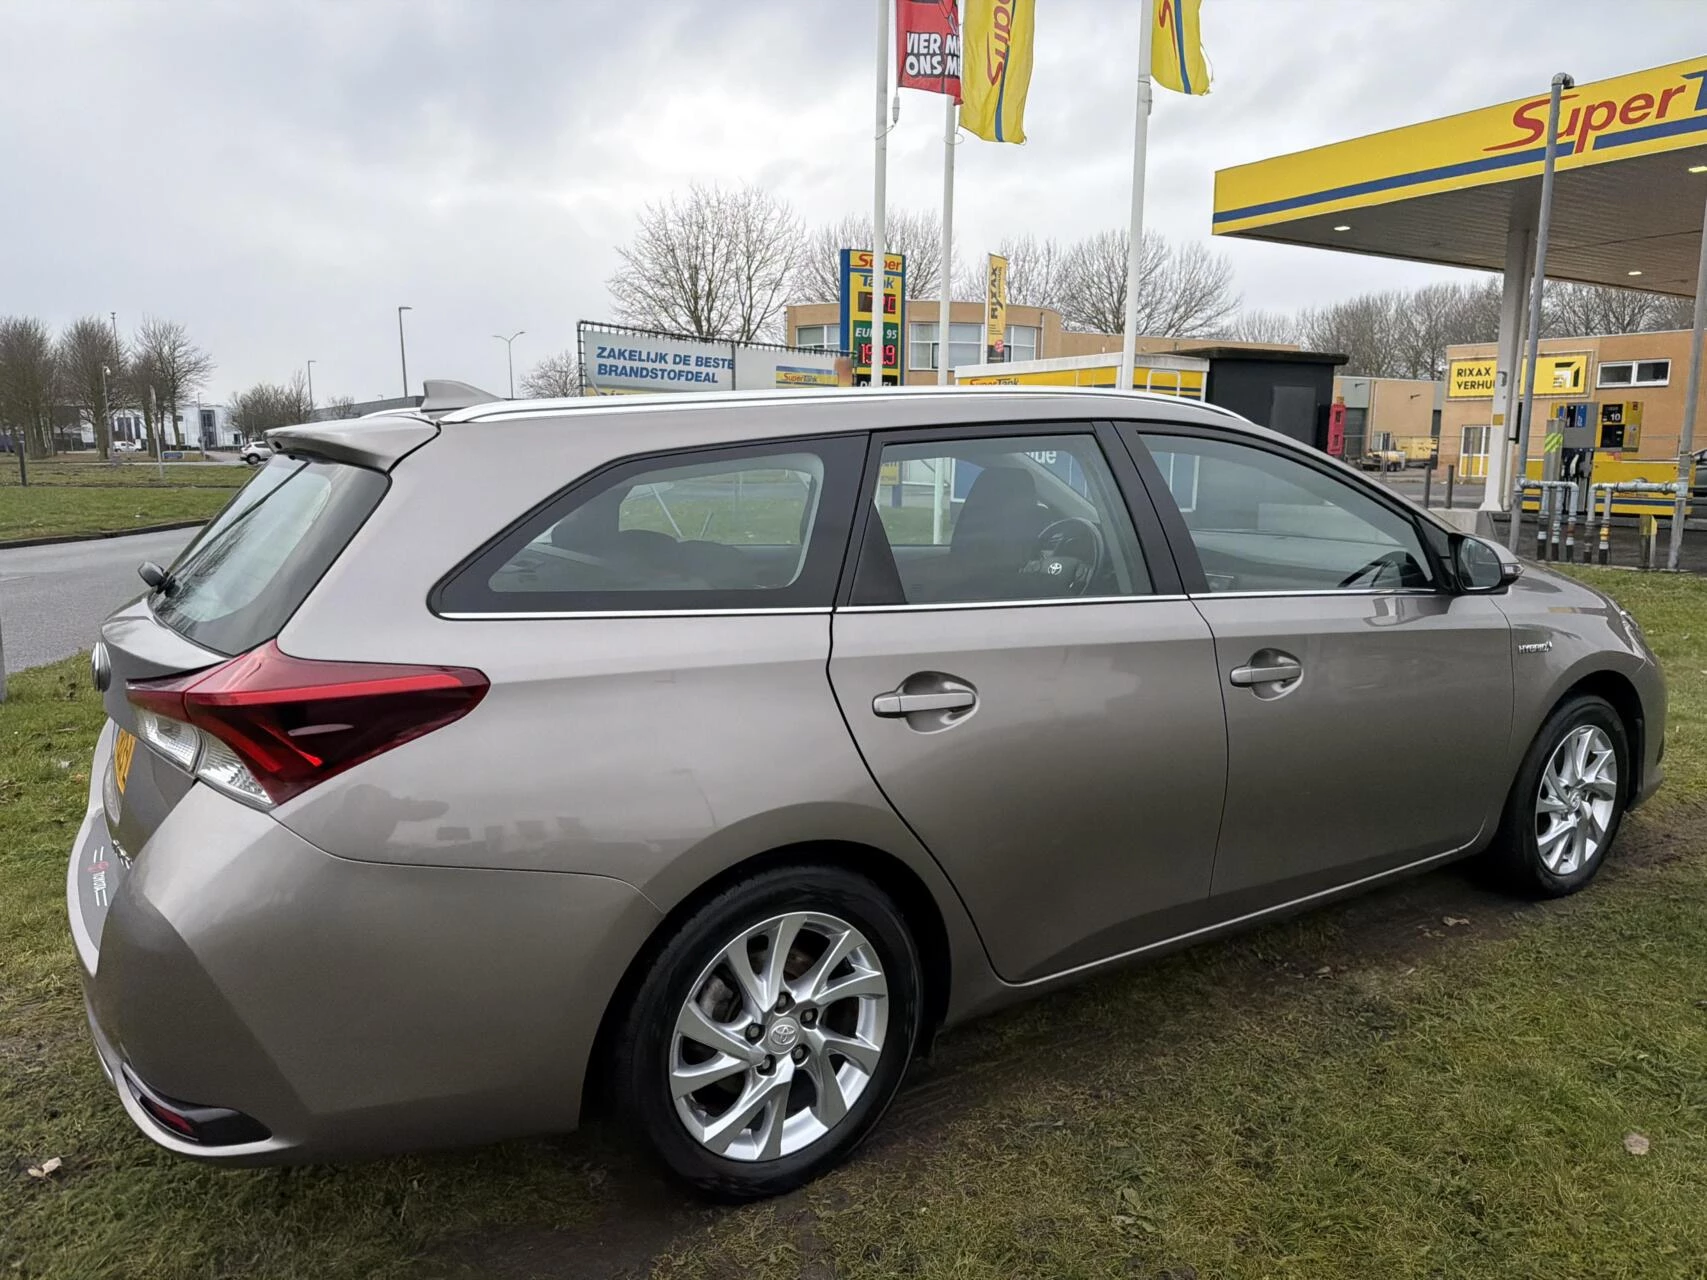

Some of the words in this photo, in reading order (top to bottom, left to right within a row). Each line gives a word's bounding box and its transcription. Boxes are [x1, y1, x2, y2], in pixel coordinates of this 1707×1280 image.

[906, 32, 941, 54] VIER
[987, 0, 1010, 86] Sup
[905, 55, 942, 76] ONS
[886, 329, 897, 339] 95
[596, 346, 668, 364] ZAKELIJK
[672, 354, 691, 366] DE
[695, 356, 735, 369] BESTE
[597, 363, 719, 383] BRANDSTOFDEAL
[1457, 367, 1491, 377] RIXAX
[1456, 379, 1496, 390] VERHU
